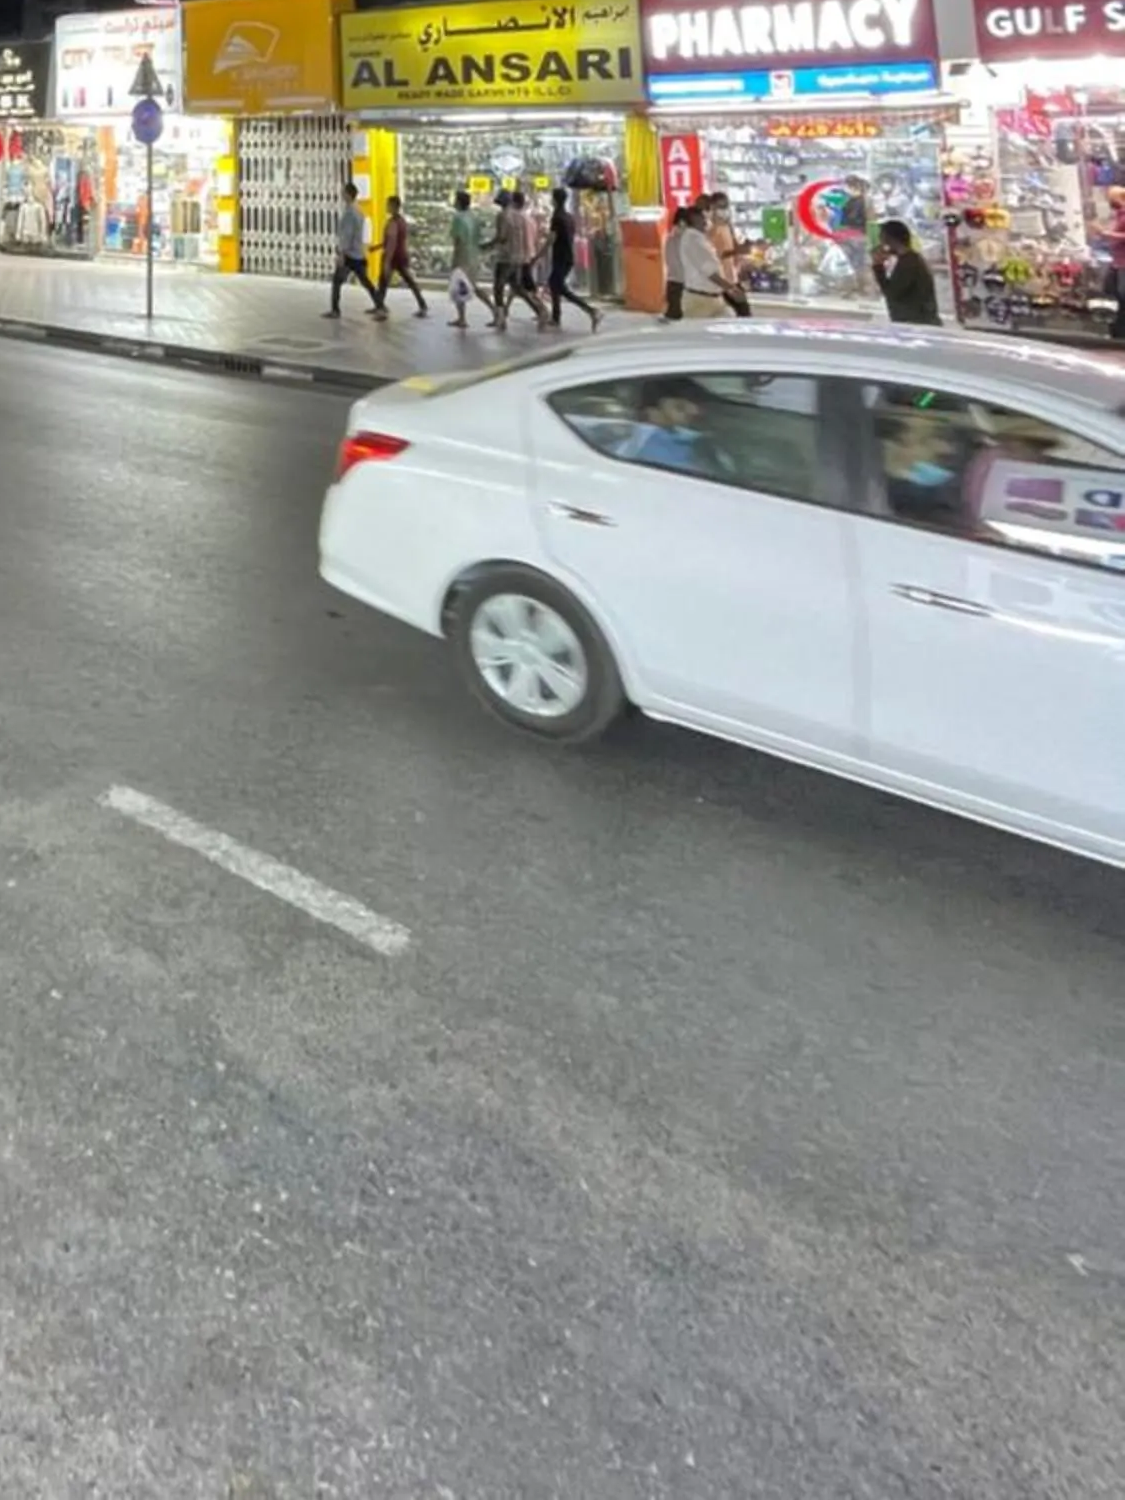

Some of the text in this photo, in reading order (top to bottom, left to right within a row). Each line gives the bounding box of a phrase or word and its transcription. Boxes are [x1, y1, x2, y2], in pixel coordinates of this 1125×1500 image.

[985, 3, 1087, 39] GULF
[351, 46, 632, 88] AL ANSARI
[667, 138, 692, 207] АПТ
